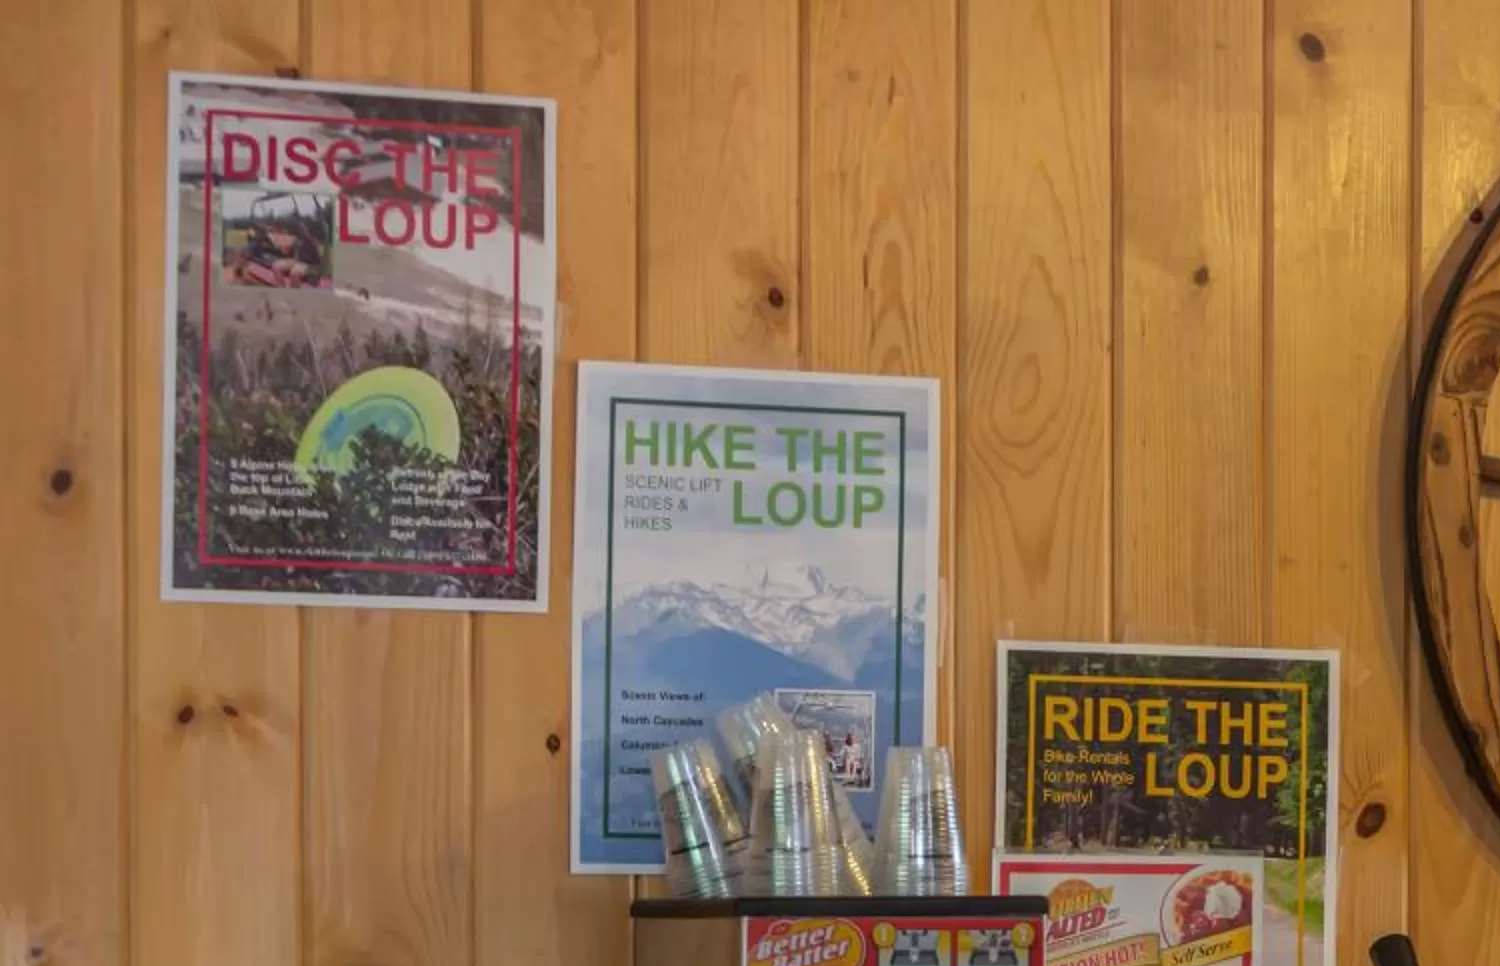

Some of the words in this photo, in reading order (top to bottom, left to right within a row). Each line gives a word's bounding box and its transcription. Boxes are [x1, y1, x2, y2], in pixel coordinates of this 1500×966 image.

[223, 132, 363, 189] DISC
[384, 143, 498, 197] THE
[338, 198, 499, 250] LOUP
[624, 419, 757, 471] HIKE
[776, 427, 886, 476] THE
[624, 474, 686, 493] SCENIC
[690, 476, 722, 494] LIFT
[624, 495, 673, 511] RIDES
[678, 497, 689, 512] &
[733, 480, 885, 529] LOUP
[624, 515, 673, 531] HIKES
[1043, 694, 1170, 745] RIDE
[1185, 701, 1289, 748] THE
[1043, 748, 1074, 764] Bike
[1079, 749, 1131, 766] Rentals
[1043, 768, 1063, 784] for
[1066, 769, 1087, 784] the
[1091, 769, 1136, 786] Whole
[1145, 751, 1289, 800] LOUP
[1043, 787, 1094, 809] Family!
